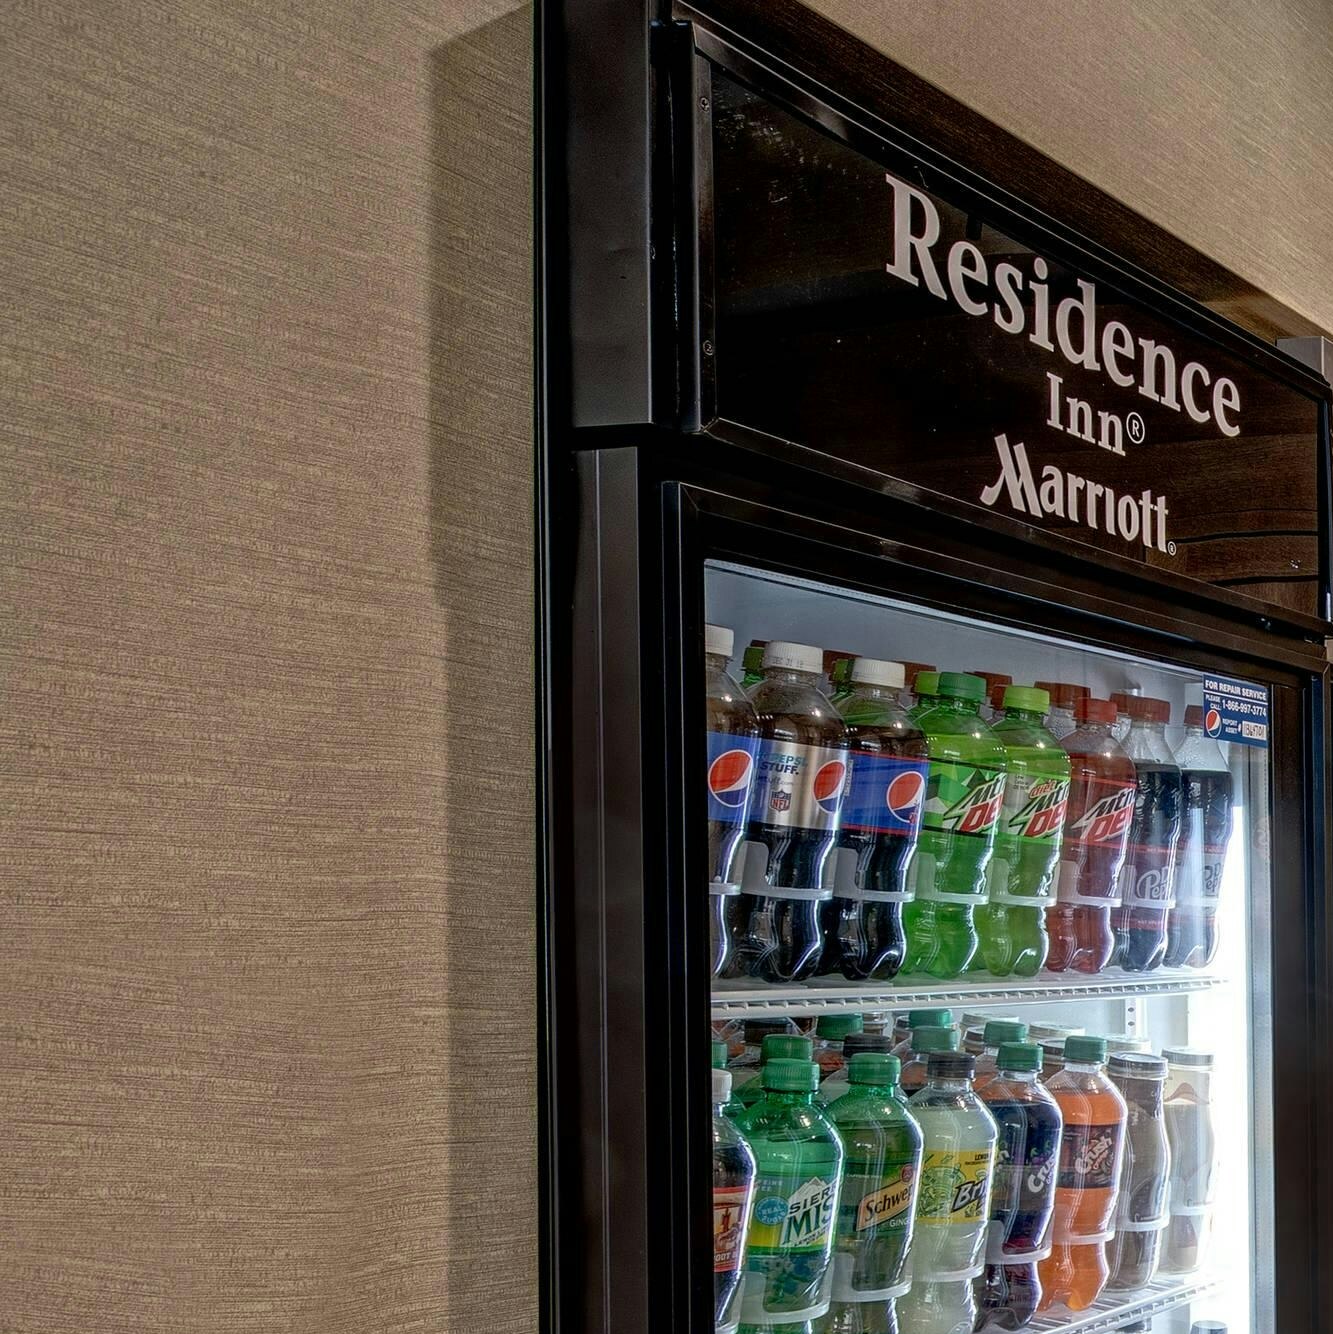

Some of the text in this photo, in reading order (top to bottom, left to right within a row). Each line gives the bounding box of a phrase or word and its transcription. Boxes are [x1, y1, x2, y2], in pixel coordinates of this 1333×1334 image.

[886, 173, 1241, 437] Residence
[1205, 680, 1266, 700] FOR REPAIR SERVICE
[1075, 1135, 1113, 1174] Crush
